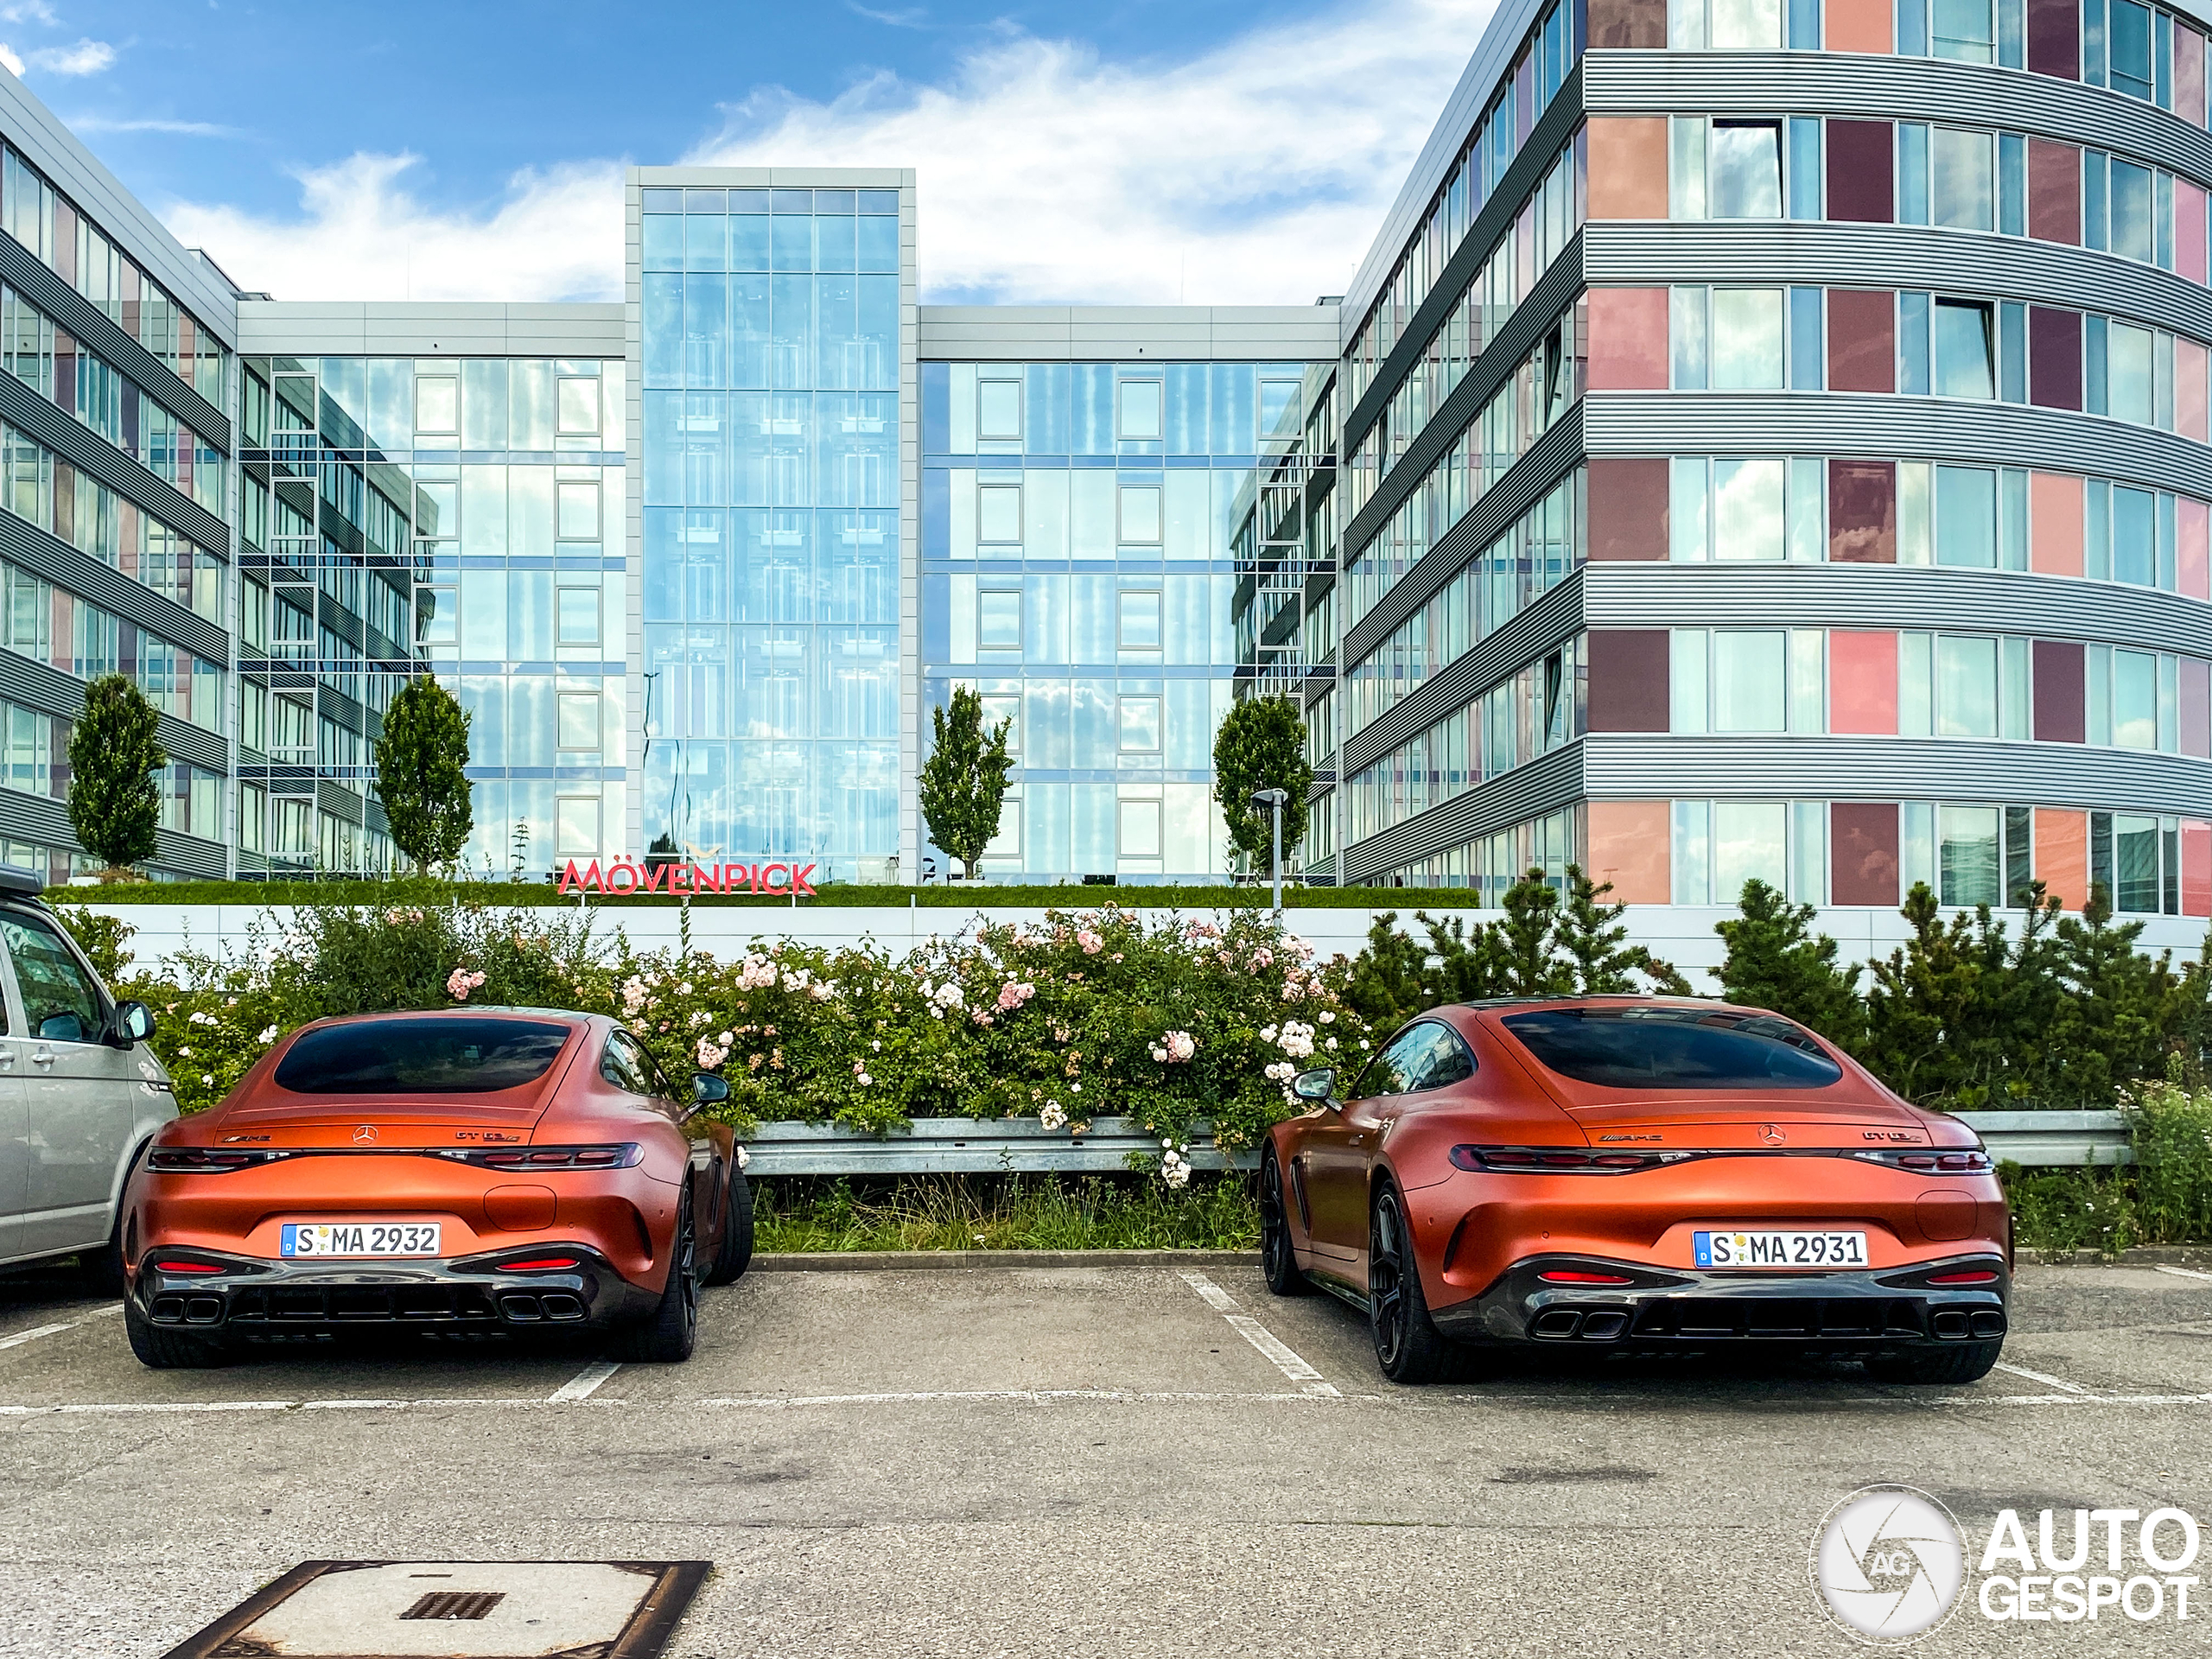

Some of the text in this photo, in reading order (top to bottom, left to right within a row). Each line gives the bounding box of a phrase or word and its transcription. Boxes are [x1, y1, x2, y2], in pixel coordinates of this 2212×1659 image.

[557, 854, 817, 896] MÖVENPICK
[455, 1131, 480, 1140] GT
[285, 1243, 292, 1251] D
[297, 1227, 435, 1253] S MA 2932
[1700, 1251, 1707, 1261] D
[1713, 1236, 1863, 1263] S MA 2931
